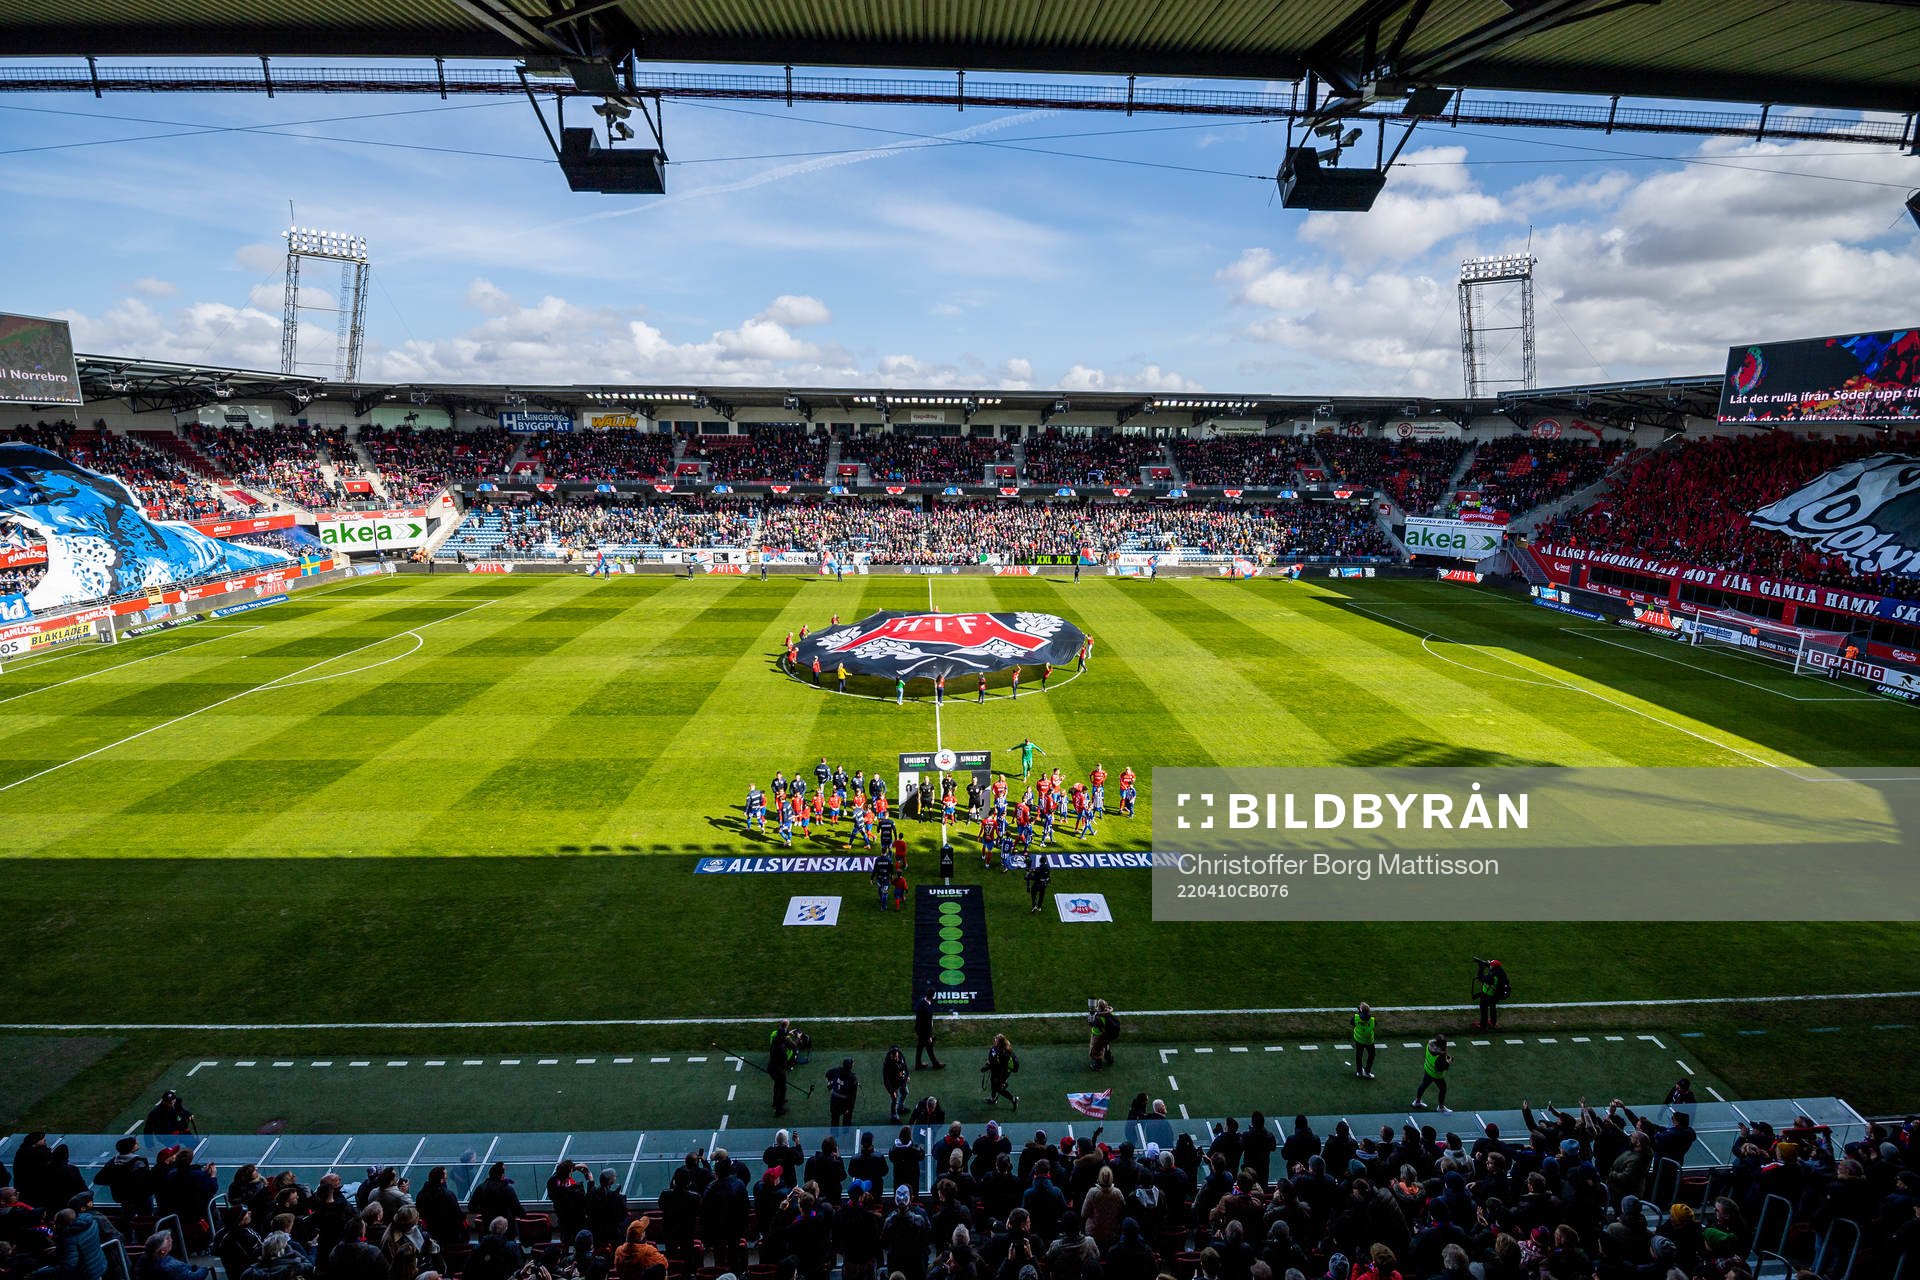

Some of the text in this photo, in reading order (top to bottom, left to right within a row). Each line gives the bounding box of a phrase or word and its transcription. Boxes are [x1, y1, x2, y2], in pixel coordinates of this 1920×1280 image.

[10, 369, 68, 382] Norrebro
[1750, 394, 1768, 403] det
[1771, 393, 1797, 403] rulla
[1832, 389, 1871, 400] Söder
[1873, 390, 1902, 401] upp
[591, 414, 639, 428] WALLIN
[382, 511, 414, 519] Scandic
[321, 522, 393, 545] akea
[1406, 527, 1467, 549] akea
[1037, 555, 1052, 565] XXL
[1057, 555, 1072, 565] XXL
[920, 566, 943, 574] OLYMPIA
[1682, 568, 1716, 585] MOT
[1760, 580, 1817, 603] GAMLA
[1824, 592, 1880, 616] HAMN,
[1892, 605, 1920, 622] SK
[0, 598, 27, 620] id
[132, 613, 199, 634] UNIBET UNIBET
[1618, 618, 1679, 637] UNIBET UNIBET
[1741, 633, 1758, 648] BOA
[1788, 647, 1808, 658] BYGET
[1814, 654, 1881, 678] CRAMO
[1876, 684, 1919, 700] UNIBET
[903, 756, 930, 764] UNIBET
[727, 857, 878, 873] ALLSVENSKAN
